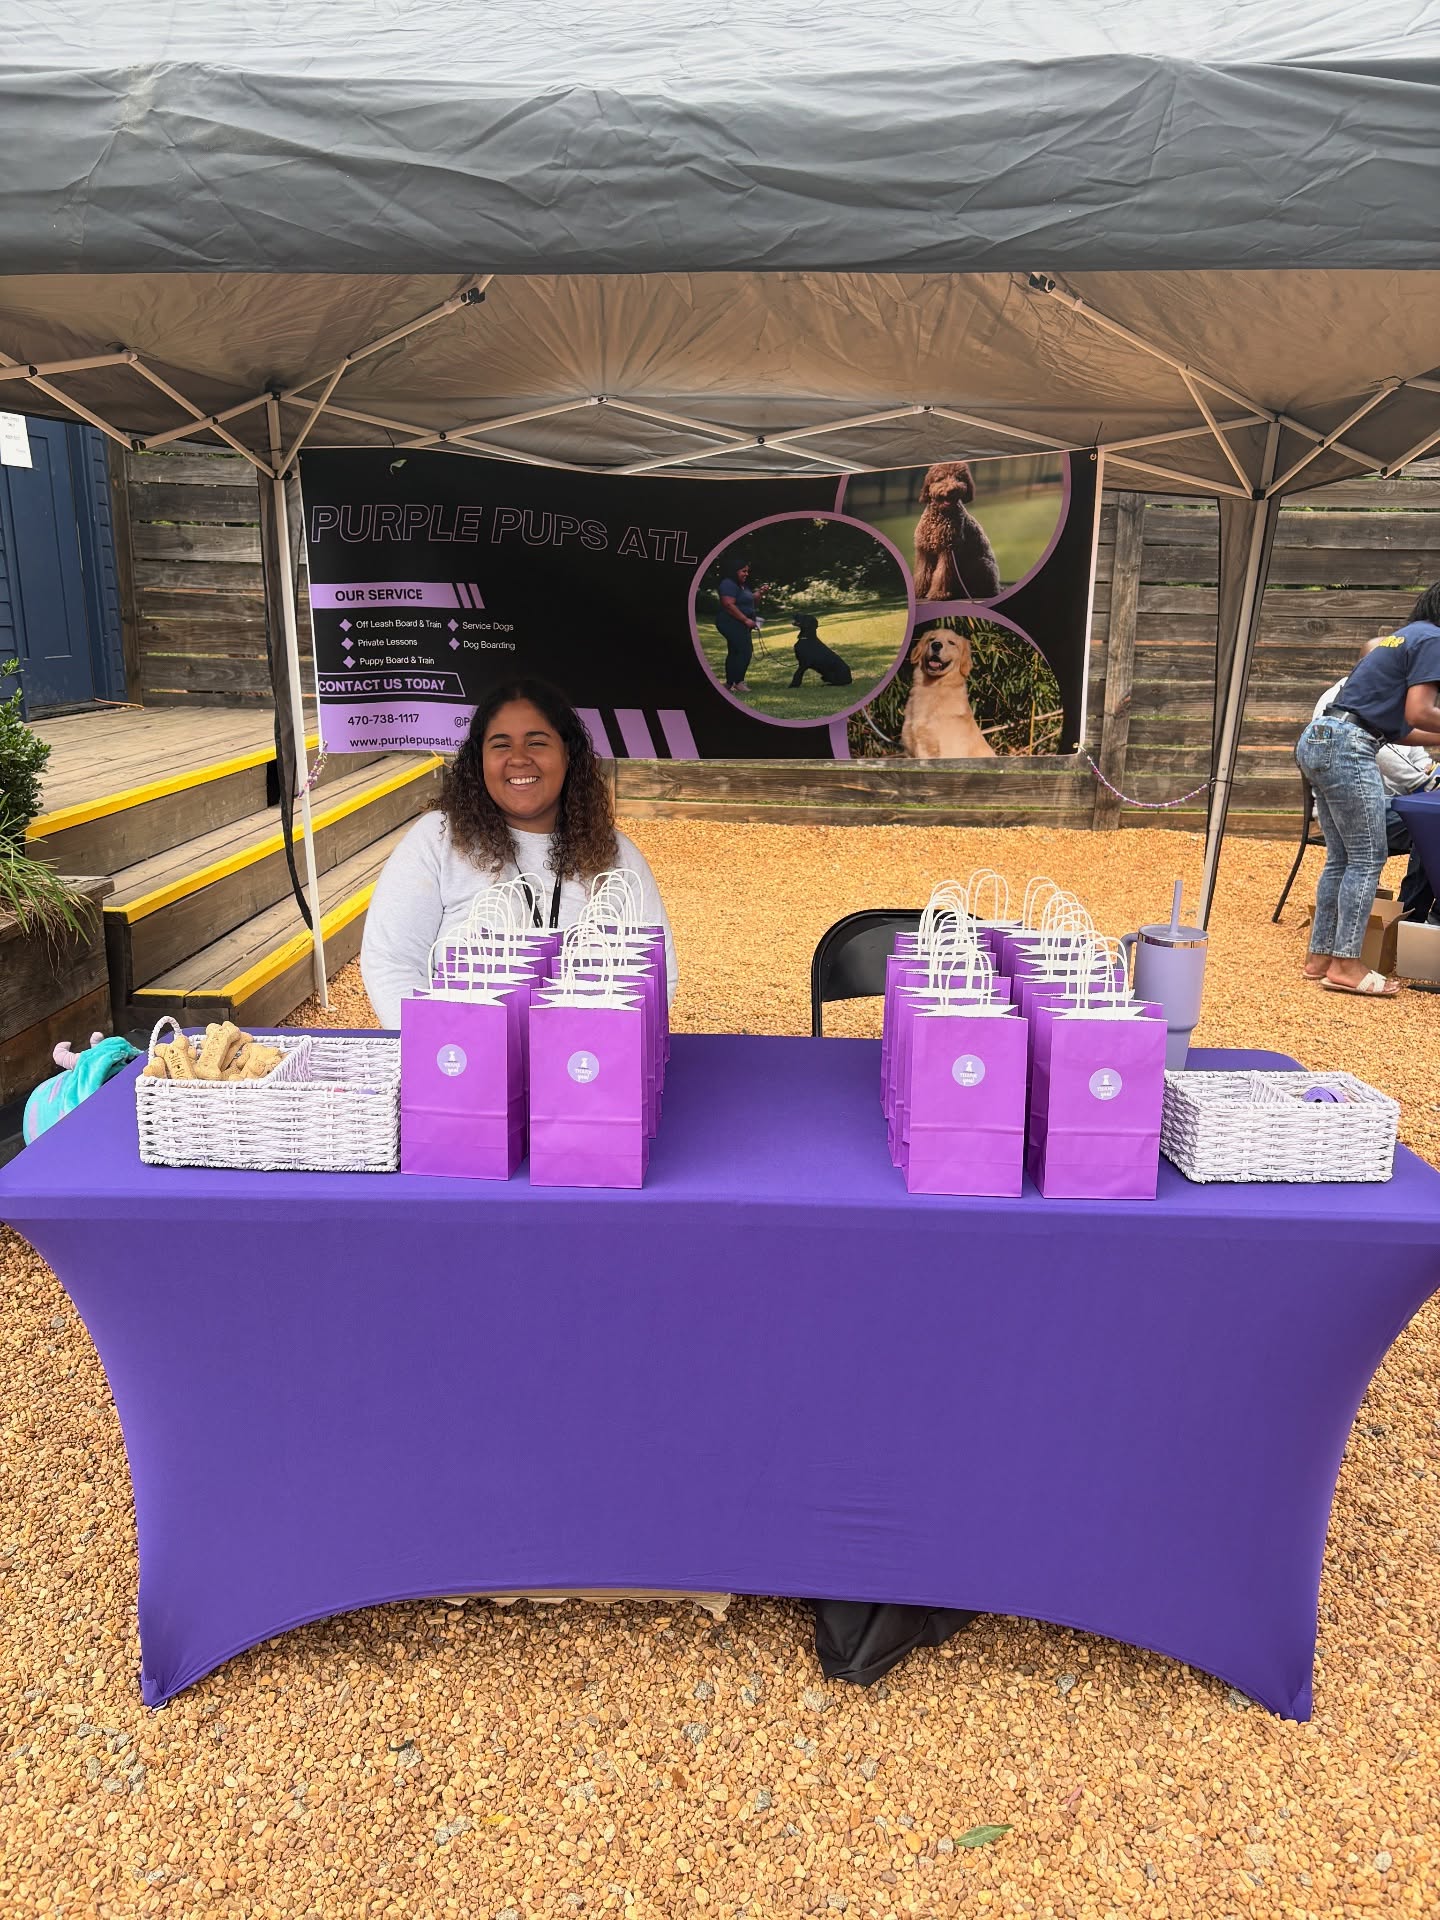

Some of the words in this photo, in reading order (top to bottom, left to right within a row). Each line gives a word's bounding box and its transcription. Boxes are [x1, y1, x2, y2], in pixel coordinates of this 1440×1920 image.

[311, 504, 482, 543] PURPLE
[491, 507, 608, 550] PUPS
[617, 527, 698, 564] ATL
[335, 589, 365, 602] OUR
[368, 588, 423, 601] SERVICE
[356, 620, 369, 629] Off
[370, 620, 394, 628] Leash
[395, 619, 418, 628] Board
[419, 620, 425, 628] &
[425, 620, 442, 629] Train
[462, 621, 491, 630] Service
[493, 622, 514, 632] Dogs
[357, 639, 384, 647] Private
[386, 638, 418, 646] Lessons
[463, 640, 479, 650] Dog
[480, 641, 516, 651] Boarding
[359, 657, 384, 667] Puppy
[386, 656, 409, 664] Board
[410, 656, 416, 664] &
[418, 656, 435, 665] Train
[318, 679, 381, 692] CONTACT
[383, 678, 403, 689] US
[404, 678, 446, 691] TODAY
[347, 713, 420, 726] 470-738-1117
